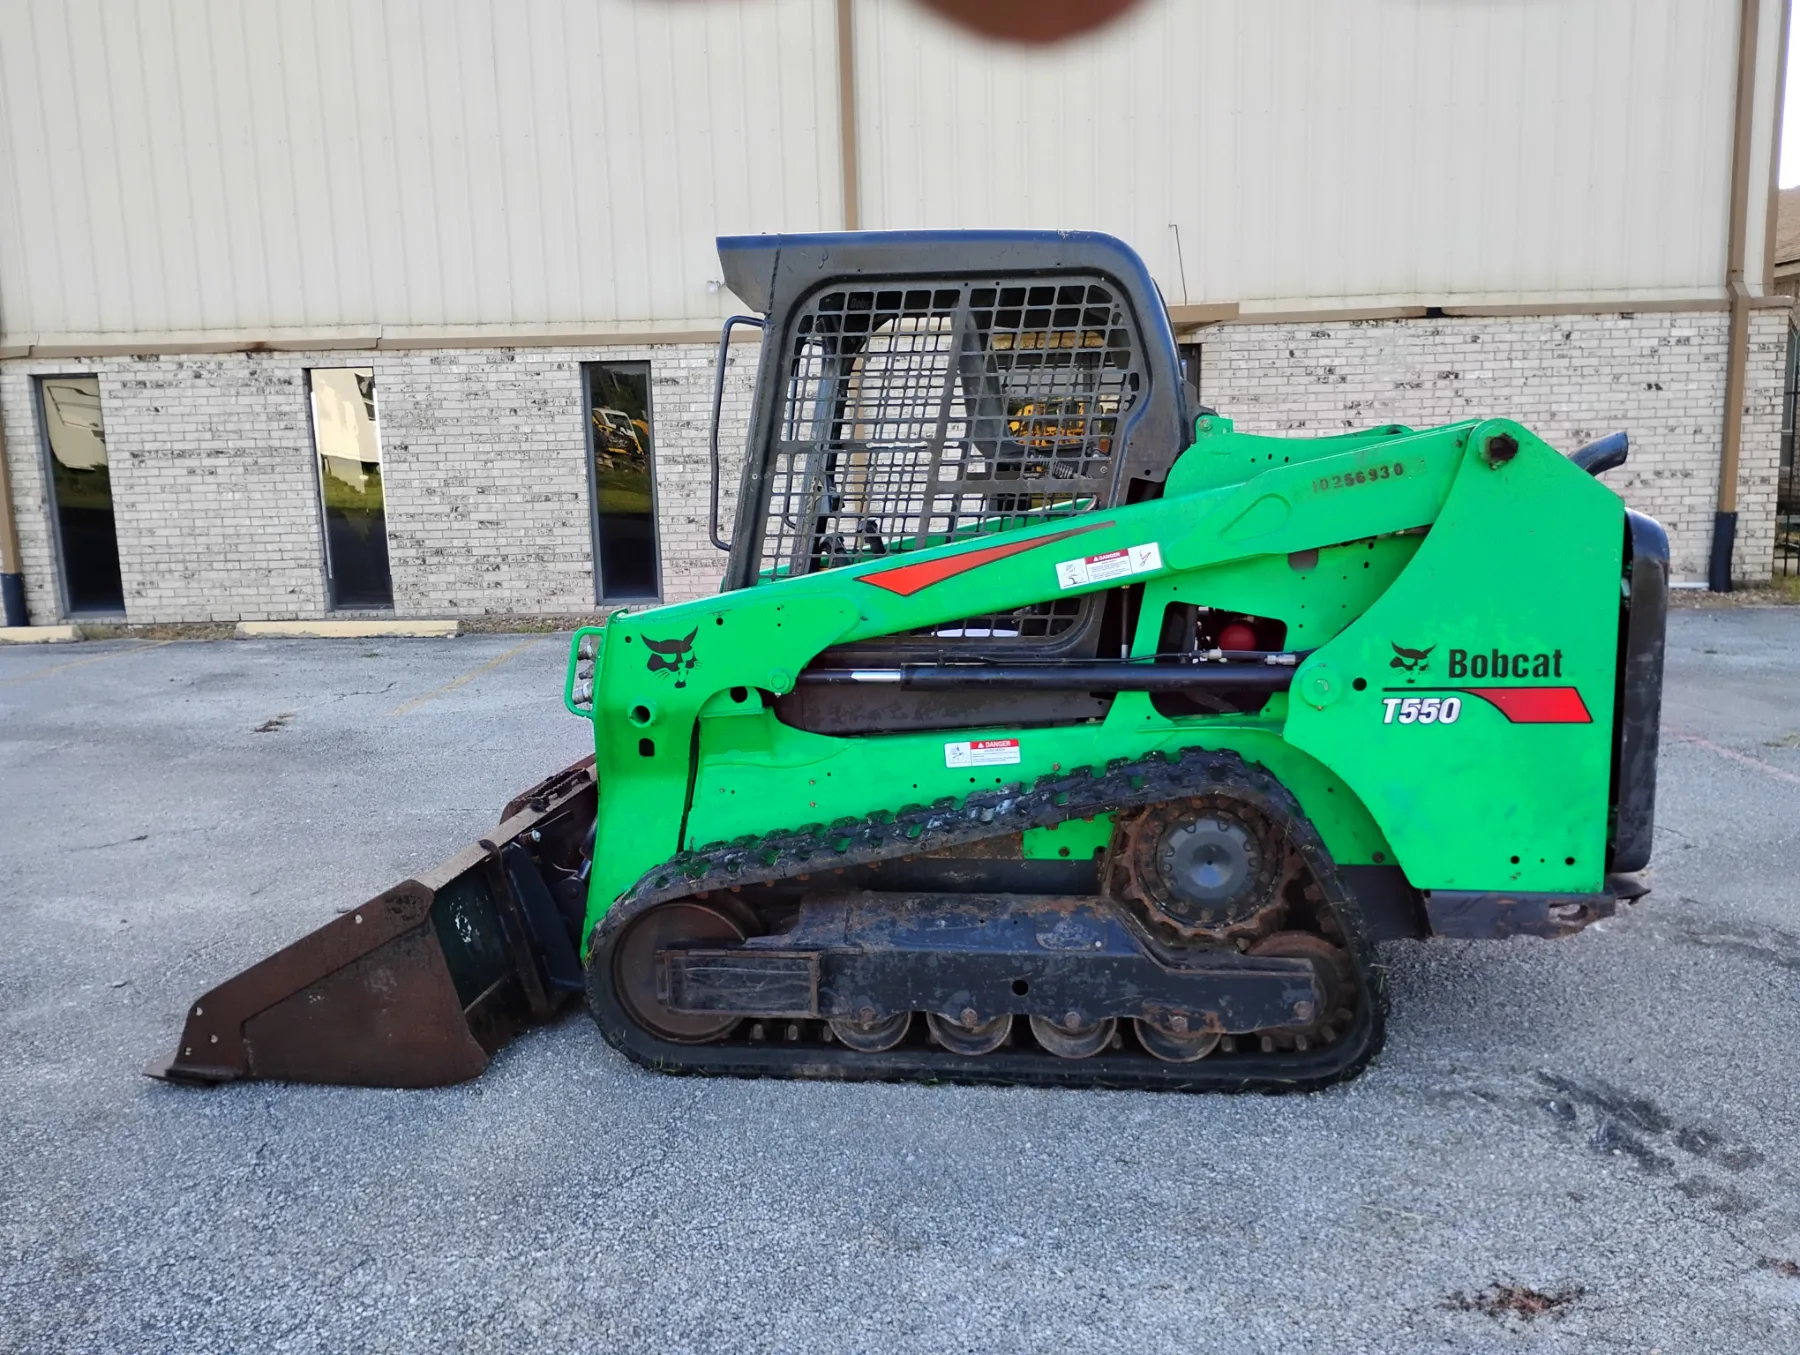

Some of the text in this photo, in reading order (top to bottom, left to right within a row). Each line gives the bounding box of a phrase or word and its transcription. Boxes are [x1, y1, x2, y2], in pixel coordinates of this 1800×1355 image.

[1448, 648, 1563, 679] Bobcat
[1382, 697, 1462, 724] T550
[985, 740, 1011, 748] DANGER
